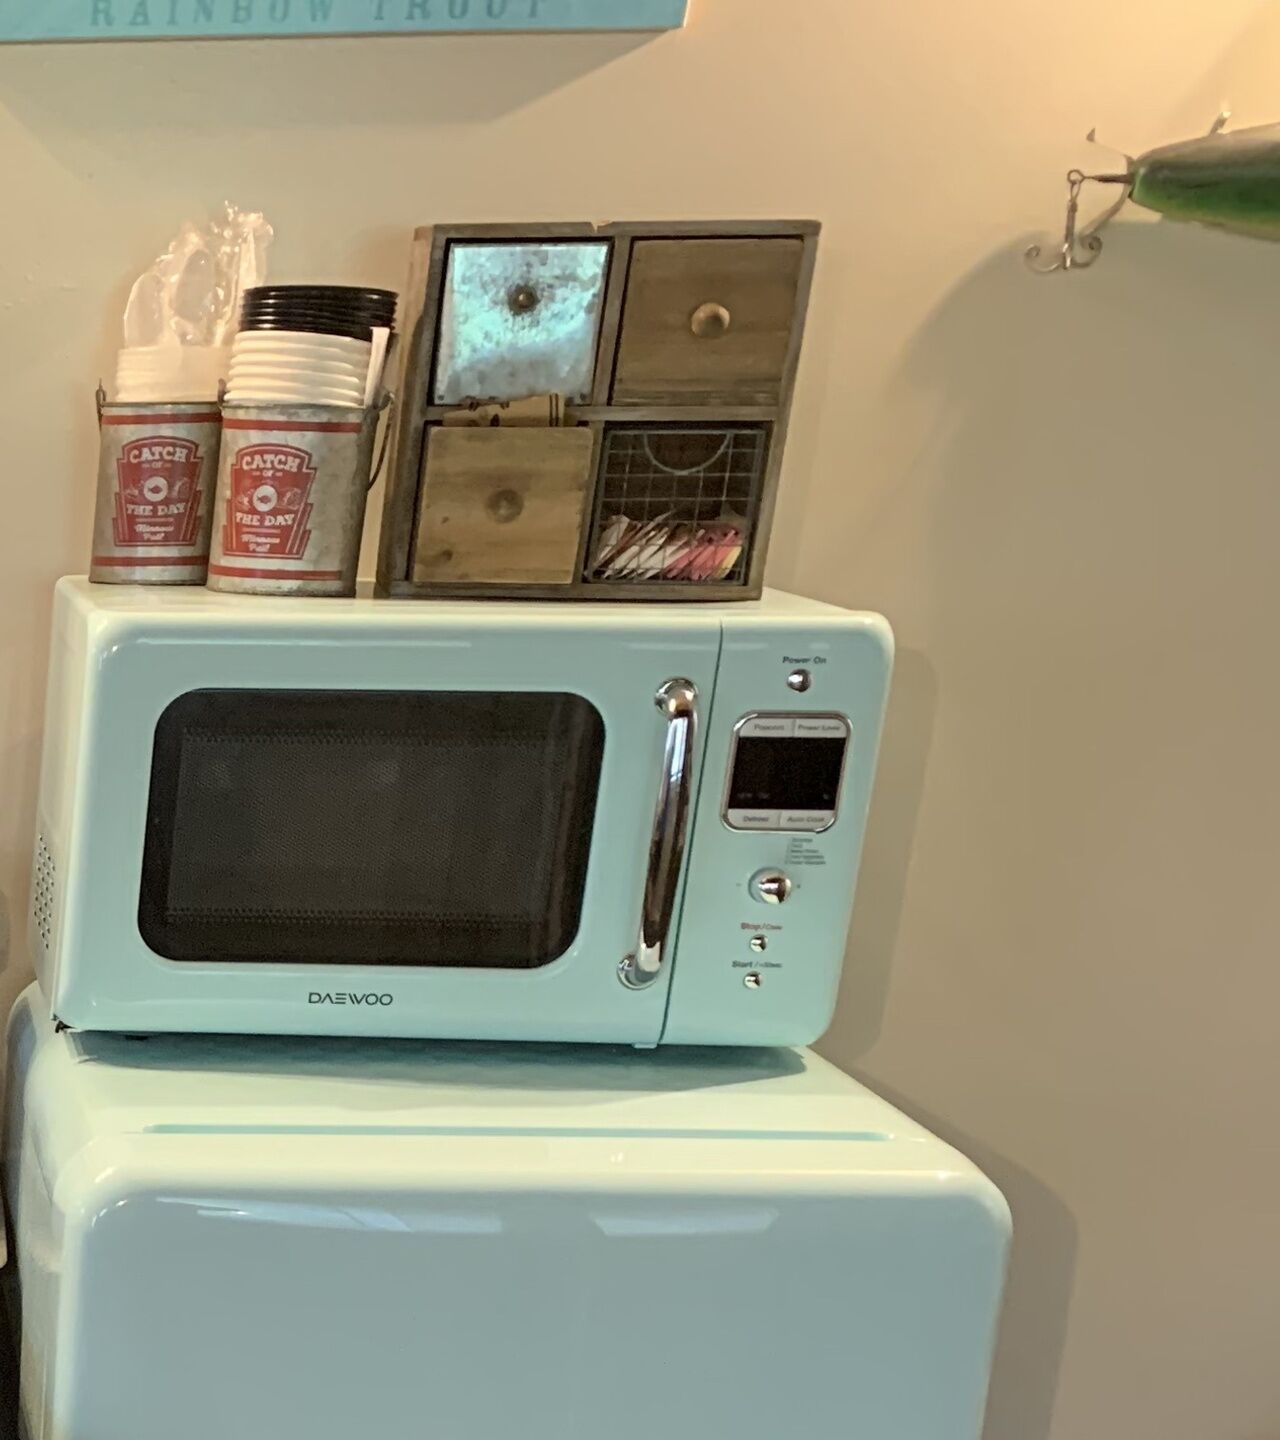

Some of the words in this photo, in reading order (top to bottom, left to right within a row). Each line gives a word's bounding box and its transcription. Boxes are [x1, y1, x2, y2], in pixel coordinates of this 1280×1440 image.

[89, 0, 333, 27] RAINBOW
[129, 446, 189, 463] CATCH
[242, 453, 301, 472] CATCH
[126, 503, 153, 515] THE
[157, 502, 186, 515] DAY
[235, 512, 261, 525] THE
[264, 514, 295, 526] DAY
[307, 992, 394, 1006] DAEWOO
